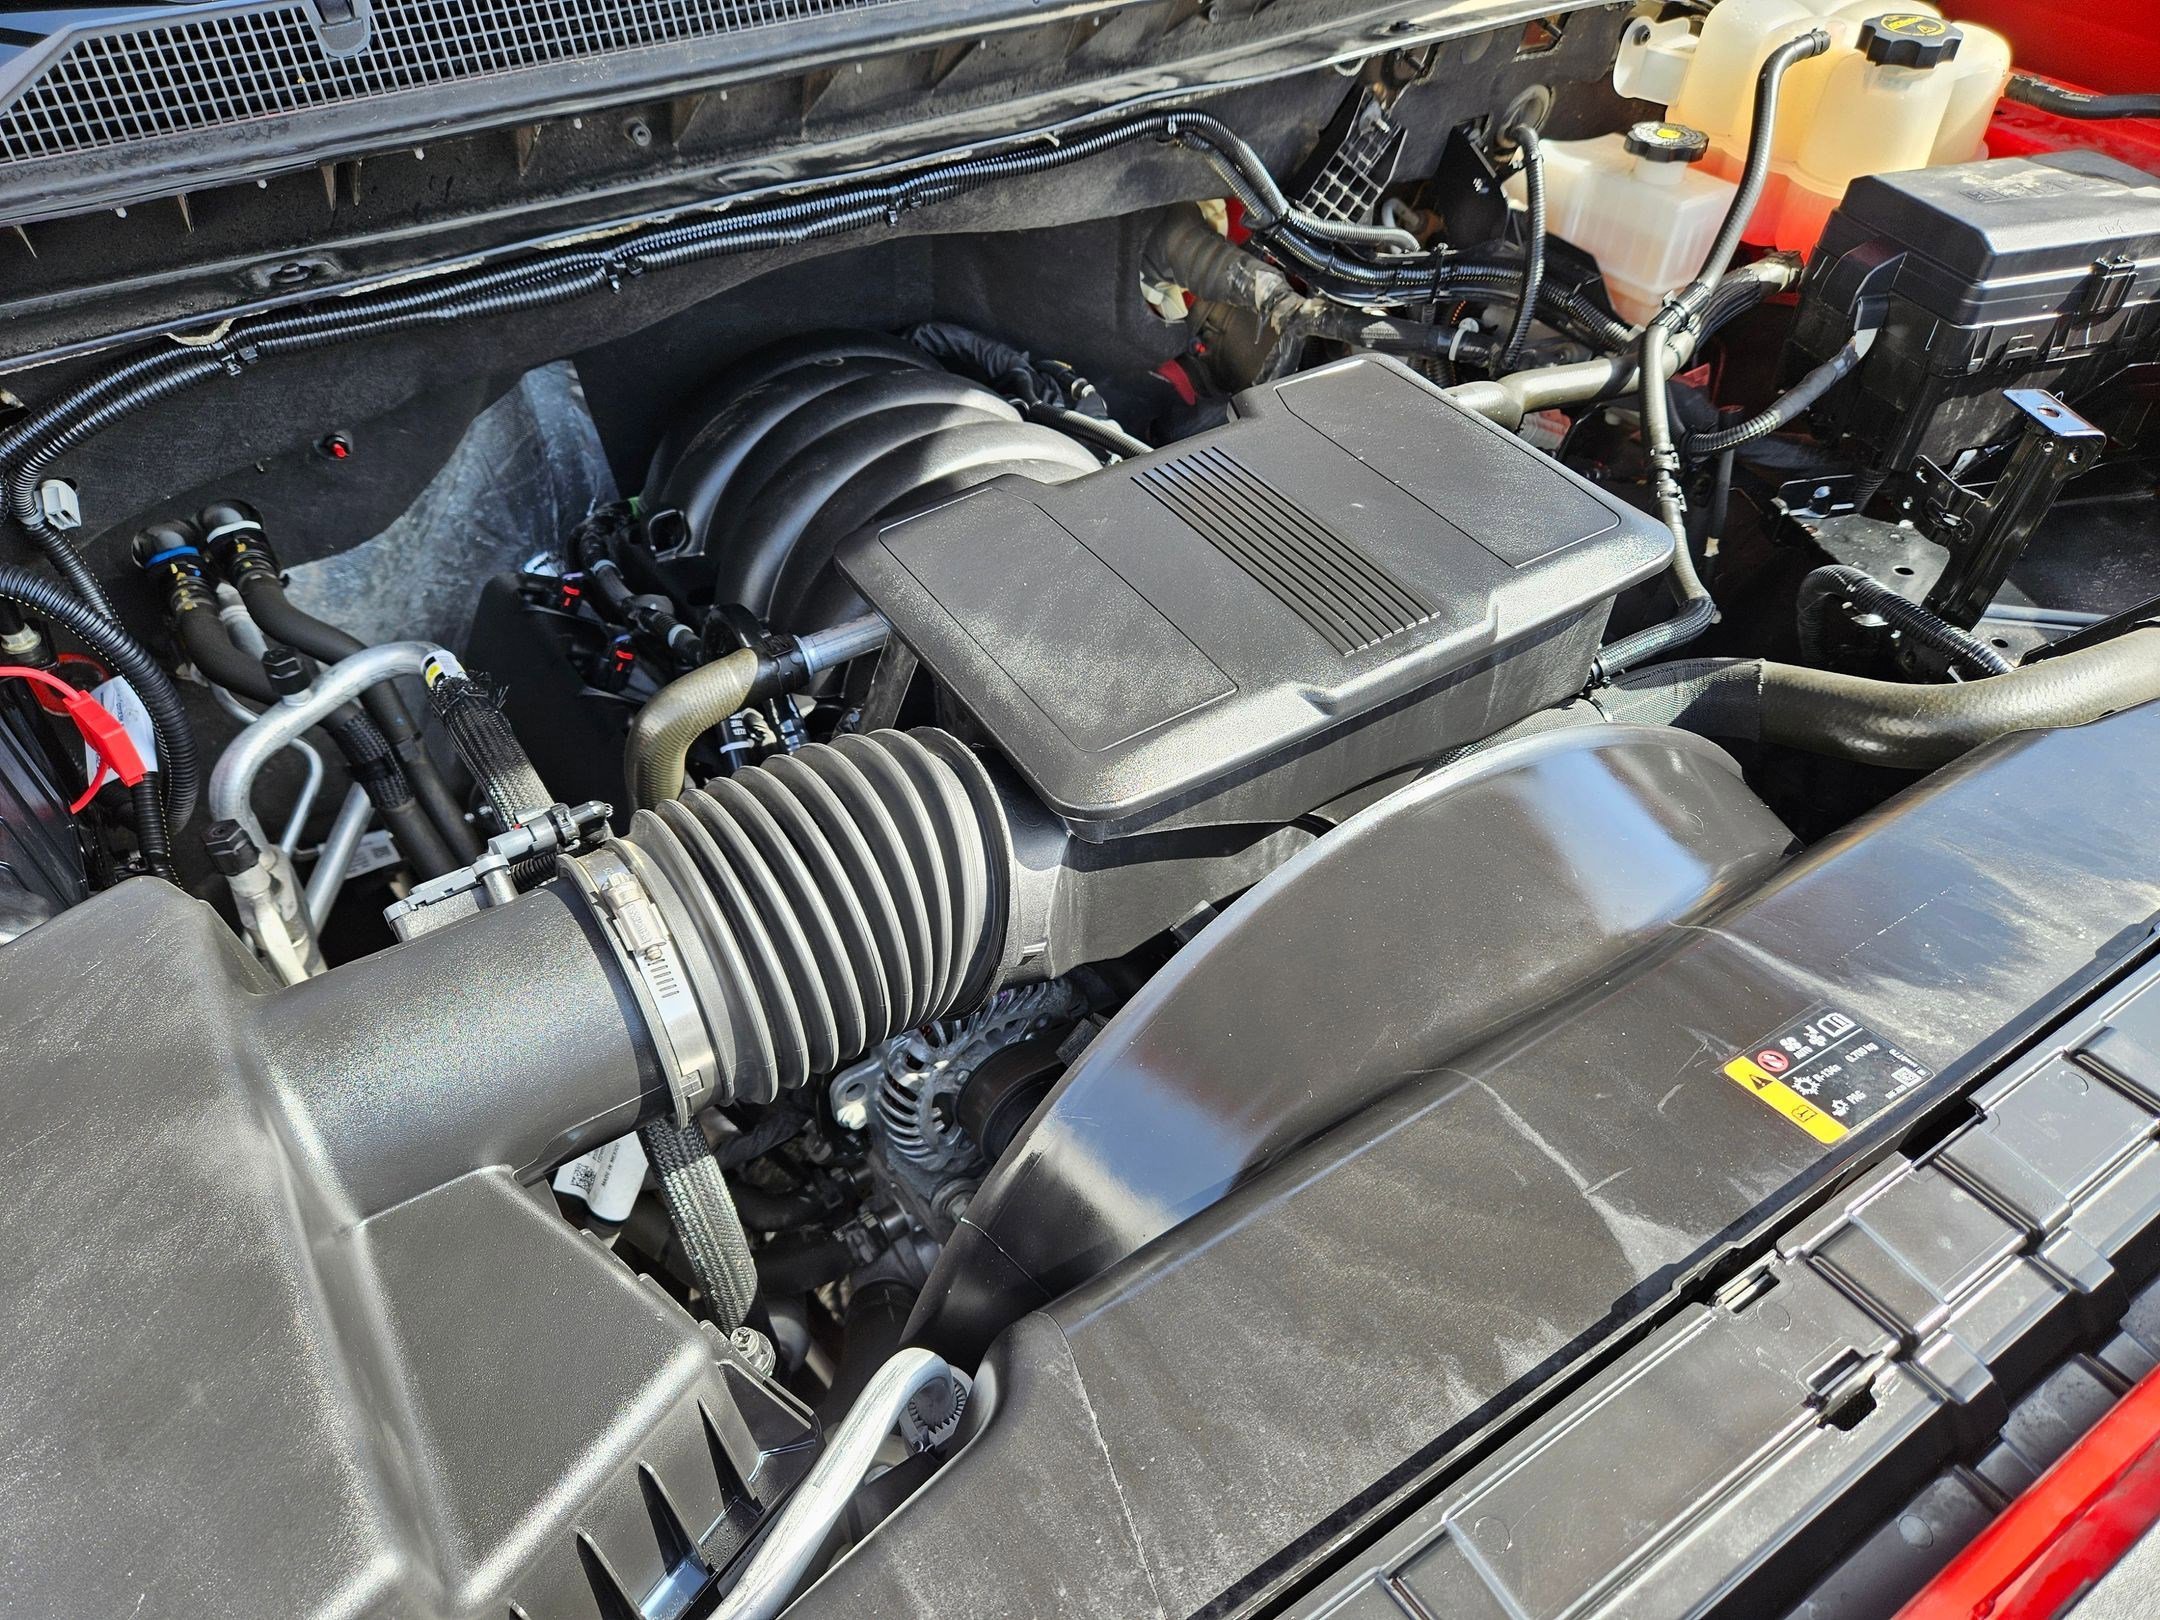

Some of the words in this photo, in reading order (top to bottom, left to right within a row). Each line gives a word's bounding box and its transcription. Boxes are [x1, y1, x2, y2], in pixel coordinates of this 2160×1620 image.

[1812, 1064, 1843, 1083] R-134a
[1845, 1090, 1867, 1105] PAG
[601, 1171, 610, 1187] MADE
